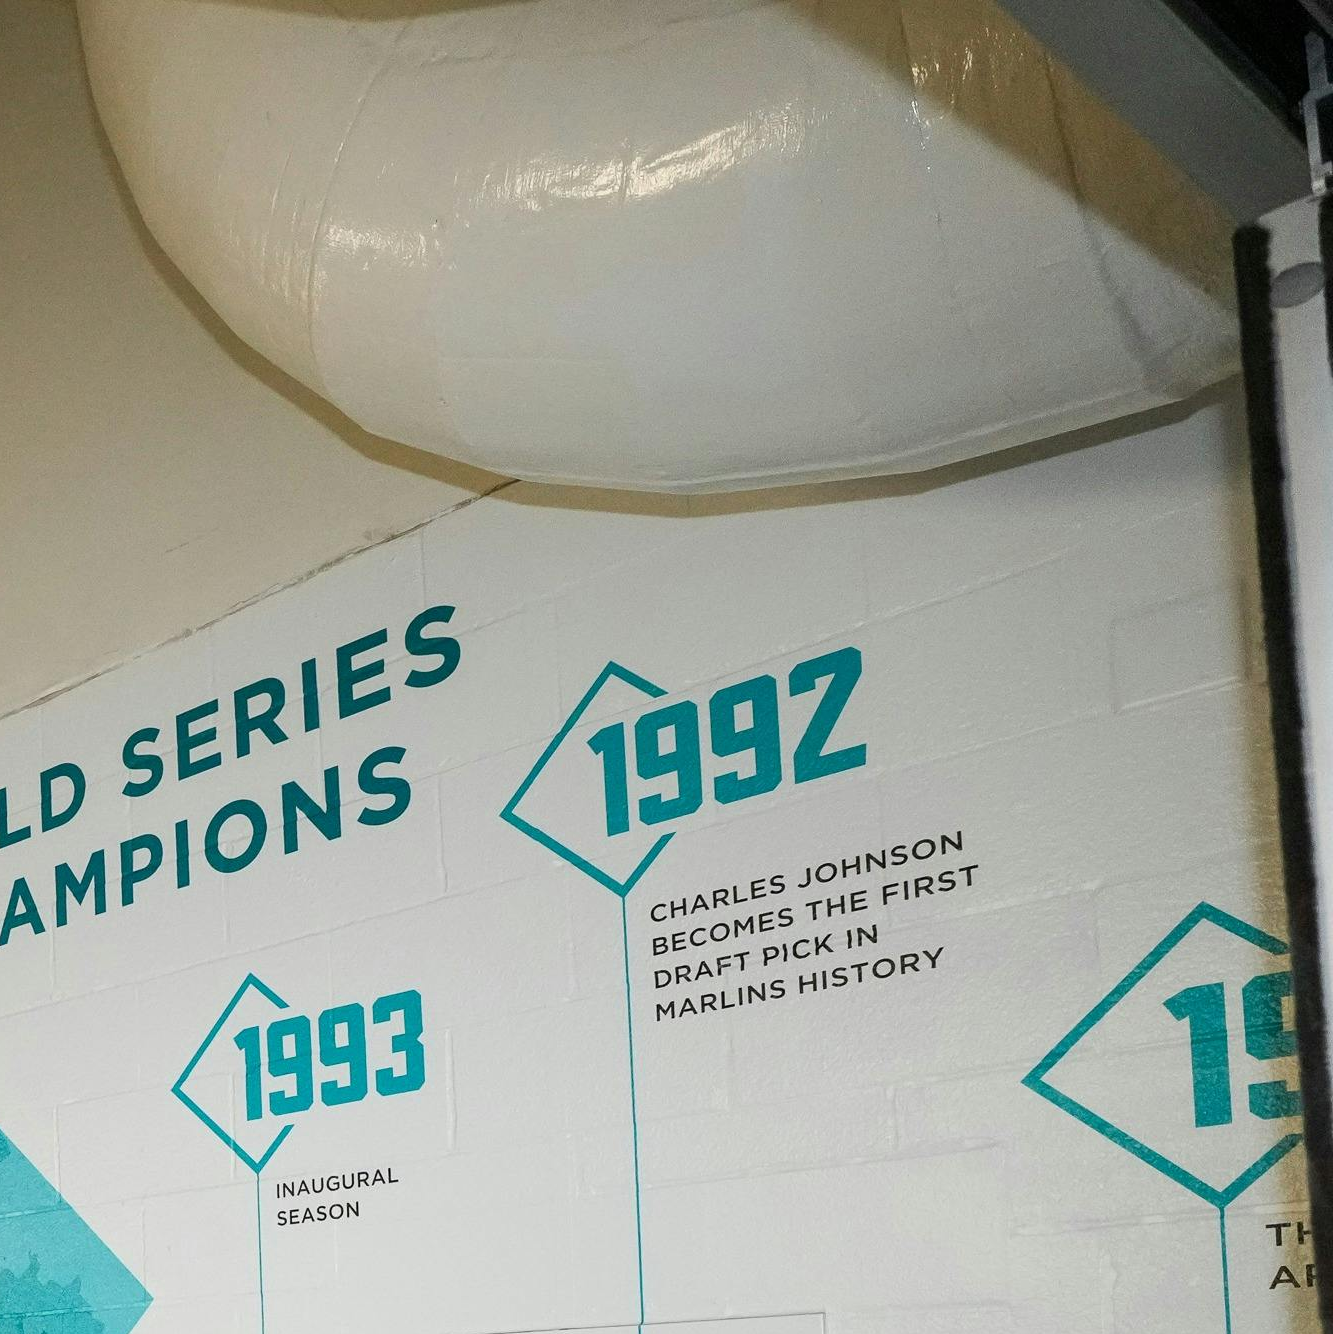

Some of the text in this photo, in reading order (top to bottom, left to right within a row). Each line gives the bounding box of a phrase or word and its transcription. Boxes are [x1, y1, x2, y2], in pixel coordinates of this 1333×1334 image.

[121, 605, 462, 798] SERIES
[586, 646, 867, 837] 1992
[650, 831, 964, 922] CHARLES JOHNSON
[652, 864, 979, 956] BECOMES THE FIRST
[653, 924, 879, 989] DRAFT PICK IN
[655, 946, 945, 1022] MARLINS HISTORY
[233, 989, 426, 1122] 1993
[275, 1167, 400, 1199] INAUGURAL
[276, 1201, 361, 1227] SEASON
